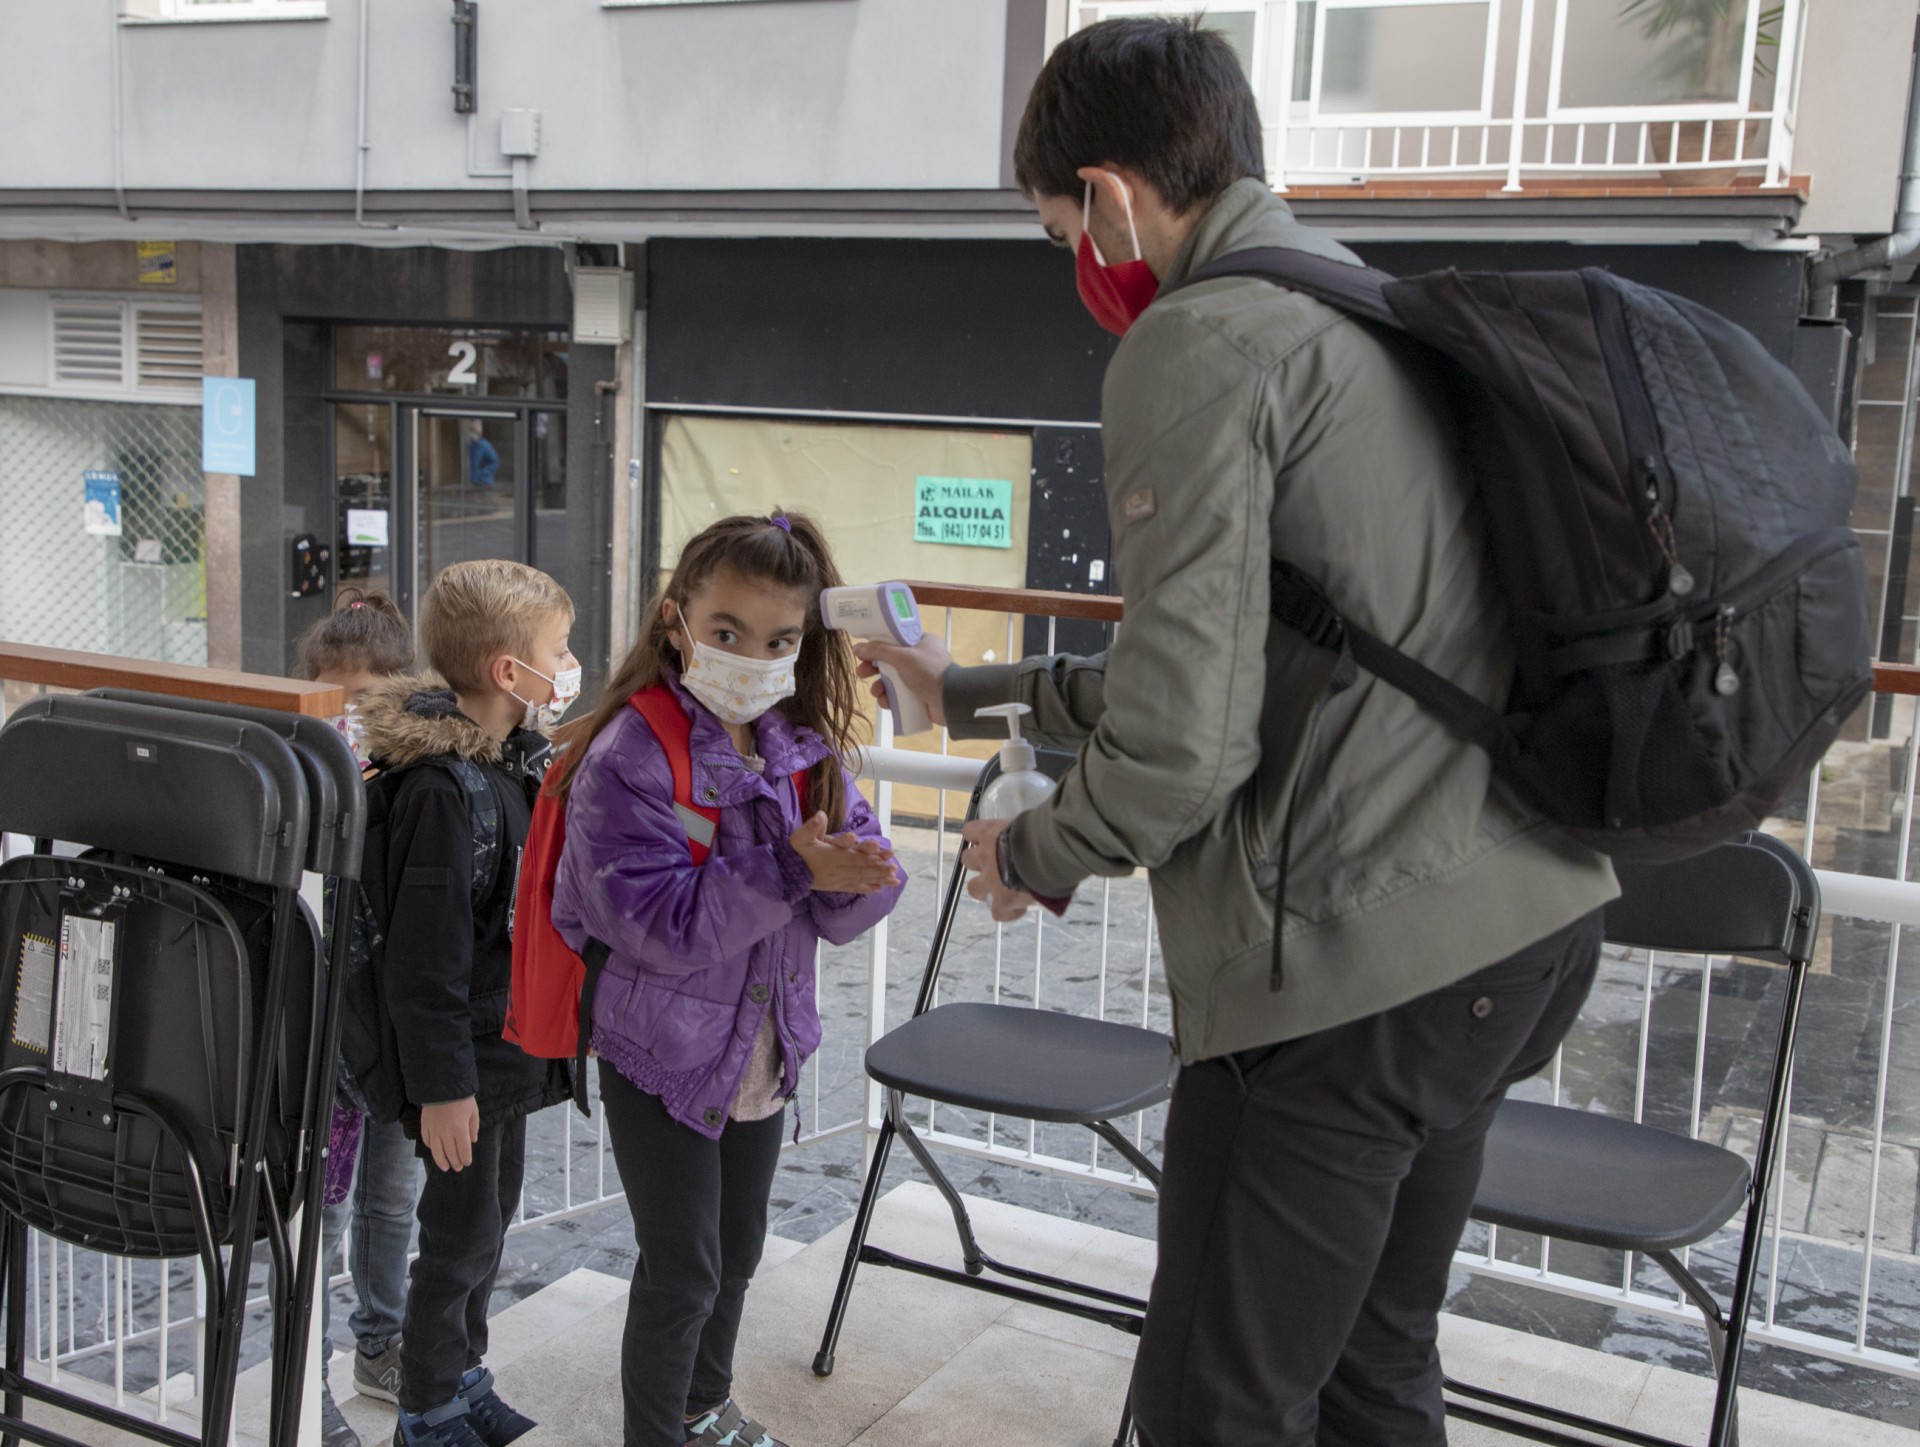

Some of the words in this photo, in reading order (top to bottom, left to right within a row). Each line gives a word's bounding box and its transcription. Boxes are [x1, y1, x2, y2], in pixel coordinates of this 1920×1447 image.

[447, 341, 477, 384] 2
[941, 486, 995, 499] MAILAK
[919, 505, 1005, 520] ALQUILA
[57, 1021, 65, 1044] black
[56, 1046, 64, 1068] Alex
